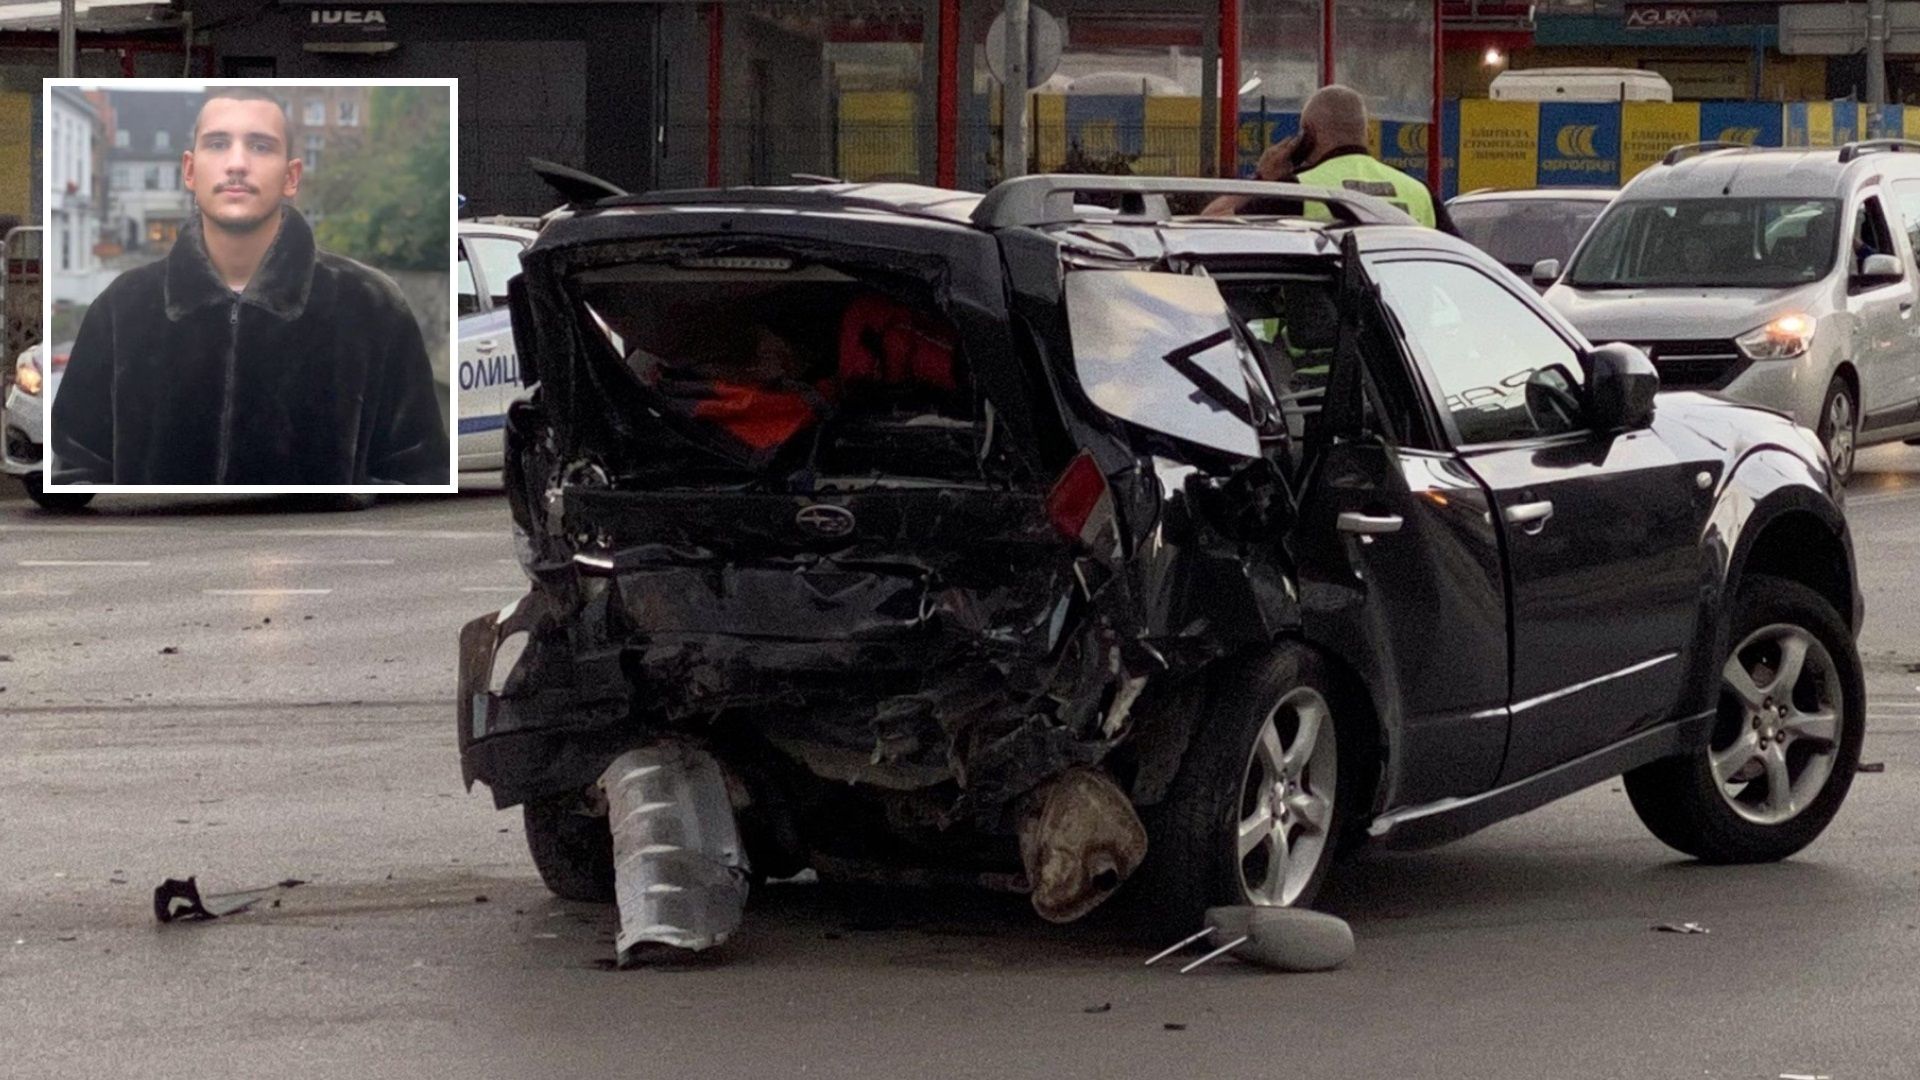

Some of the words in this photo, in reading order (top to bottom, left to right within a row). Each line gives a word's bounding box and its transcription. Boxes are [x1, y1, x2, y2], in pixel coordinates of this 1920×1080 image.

[310, 10, 386, 24] IDEA
[1626, 9, 1692, 26] AGURA
[459, 354, 519, 390] ОЛИЦ
